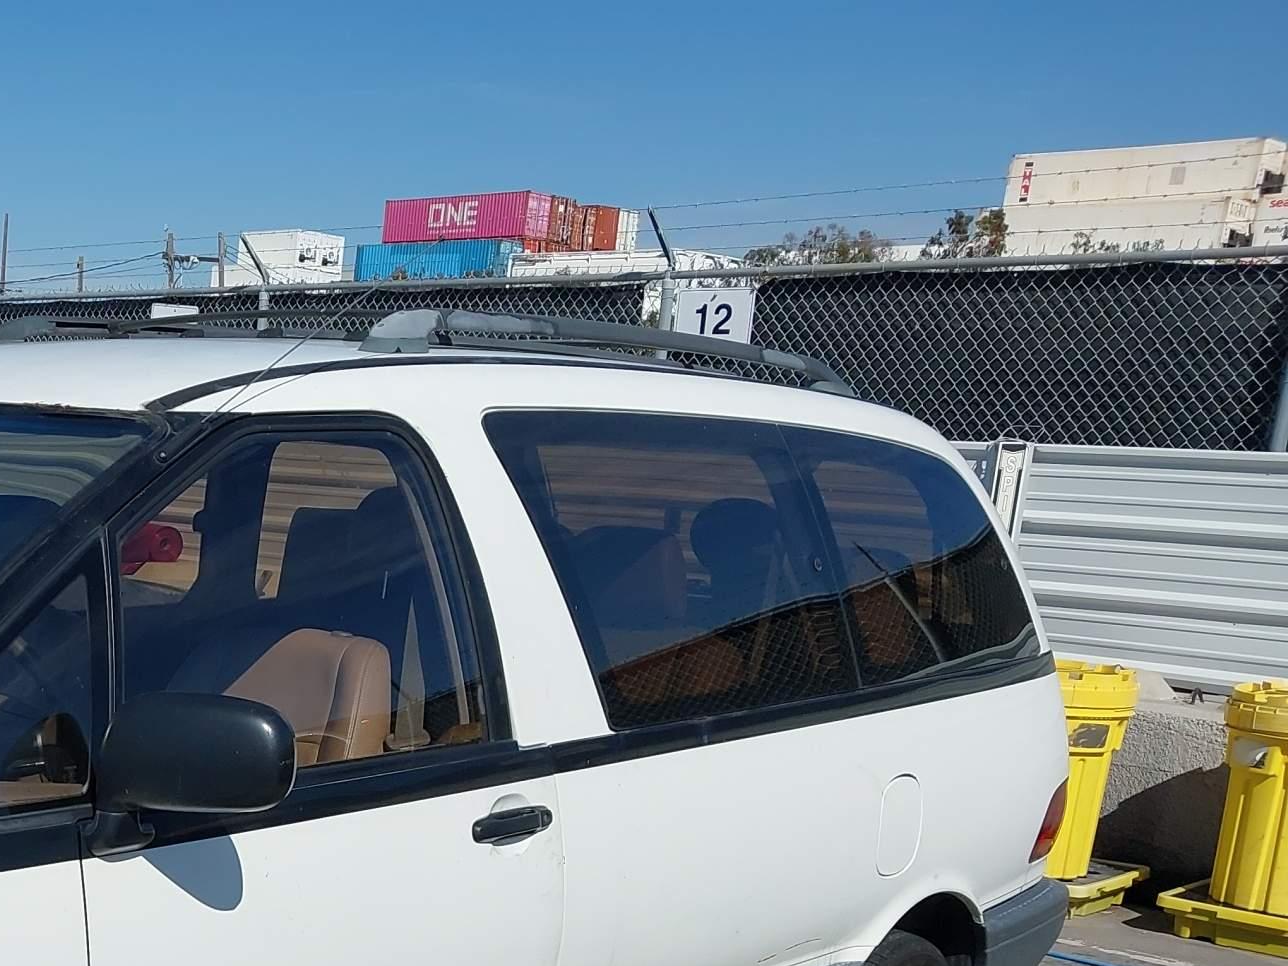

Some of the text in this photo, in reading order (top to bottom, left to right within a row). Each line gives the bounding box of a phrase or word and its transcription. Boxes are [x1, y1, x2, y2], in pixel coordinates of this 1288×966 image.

[1020, 169, 1032, 194] TAL
[427, 201, 478, 228] ONE
[696, 303, 733, 335] 12
